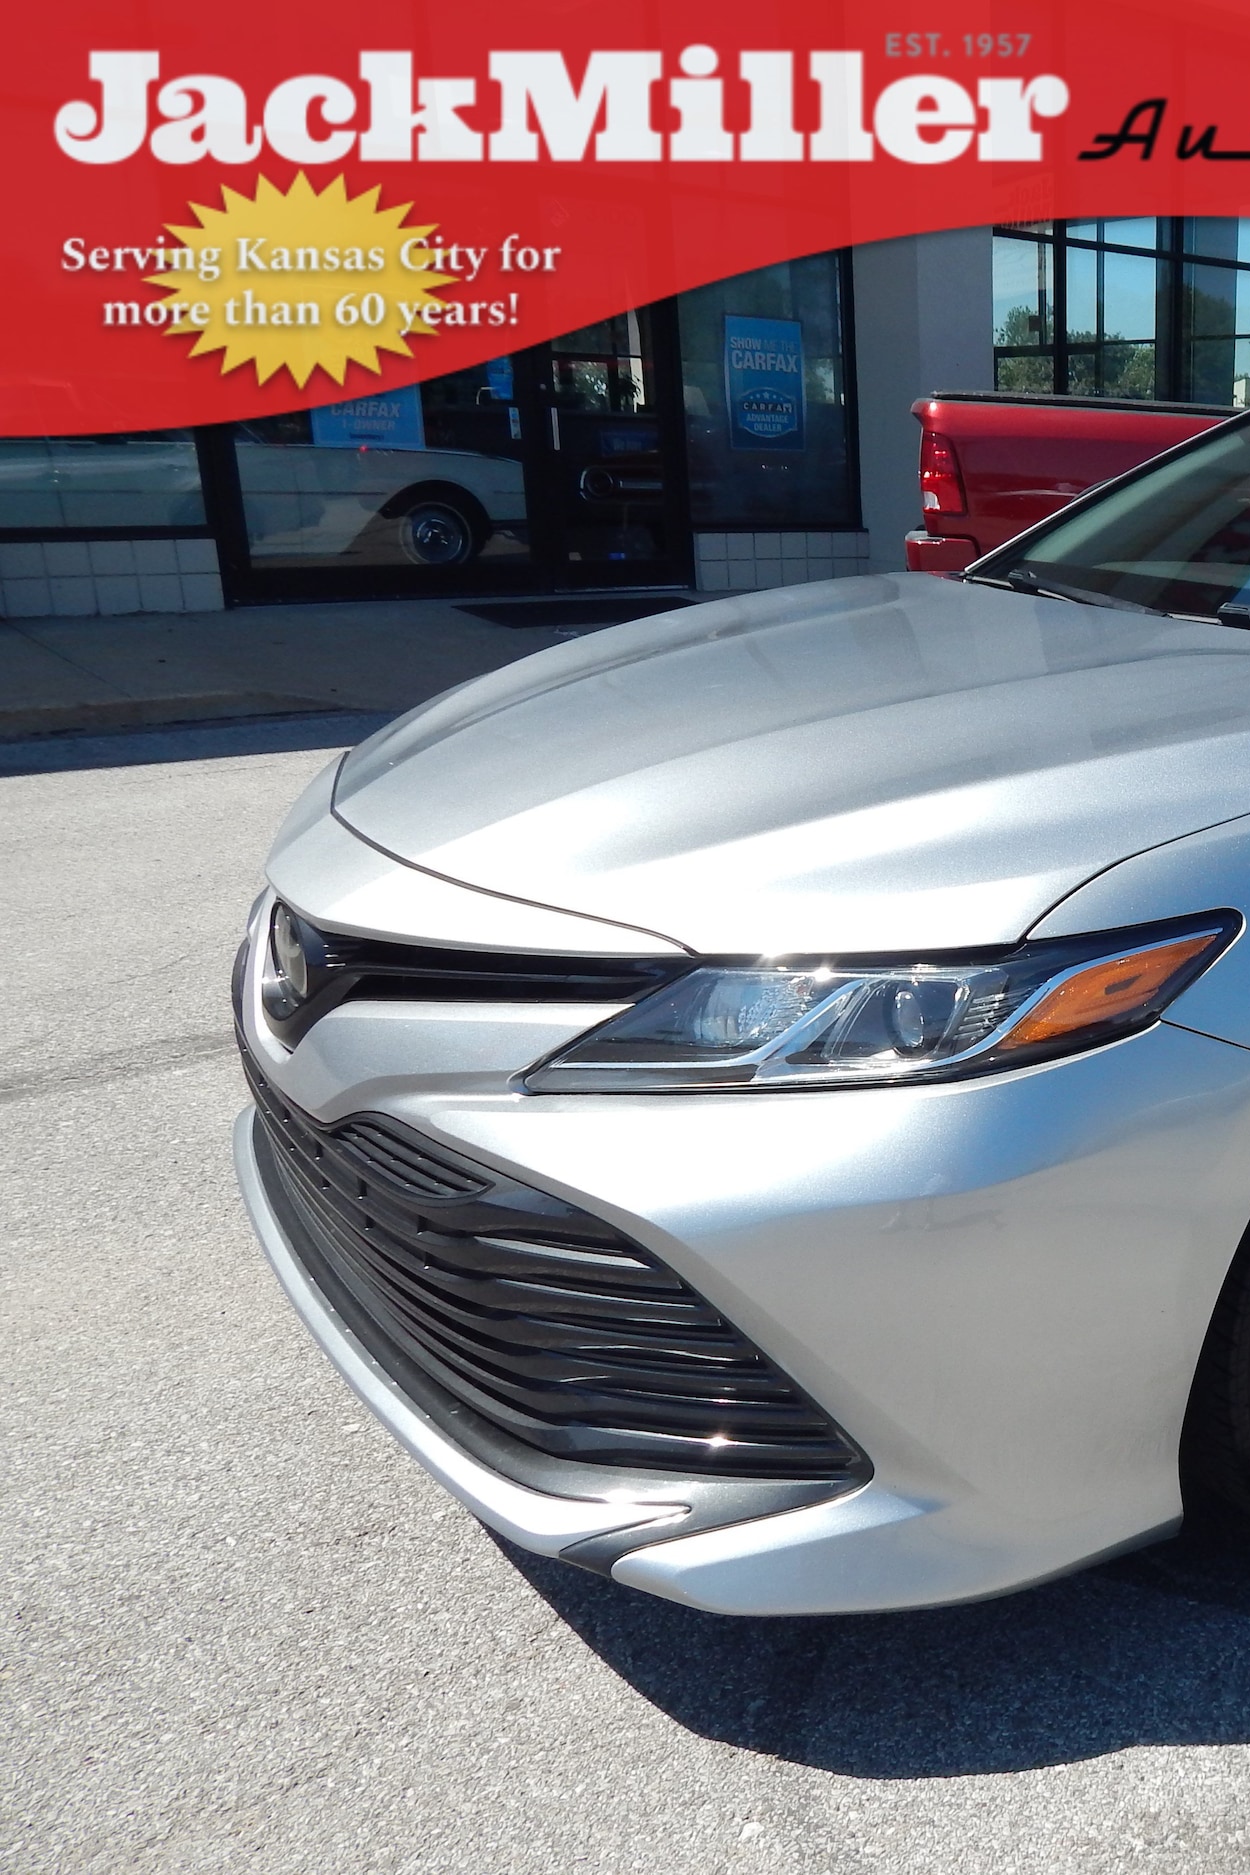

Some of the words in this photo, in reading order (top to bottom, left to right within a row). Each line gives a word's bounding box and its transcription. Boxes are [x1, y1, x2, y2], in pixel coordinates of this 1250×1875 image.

[730, 336, 762, 350] SHOW
[731, 350, 798, 373] CARFAX
[746, 413, 789, 423] ADVANTAGE
[753, 423, 782, 432] DEALER
